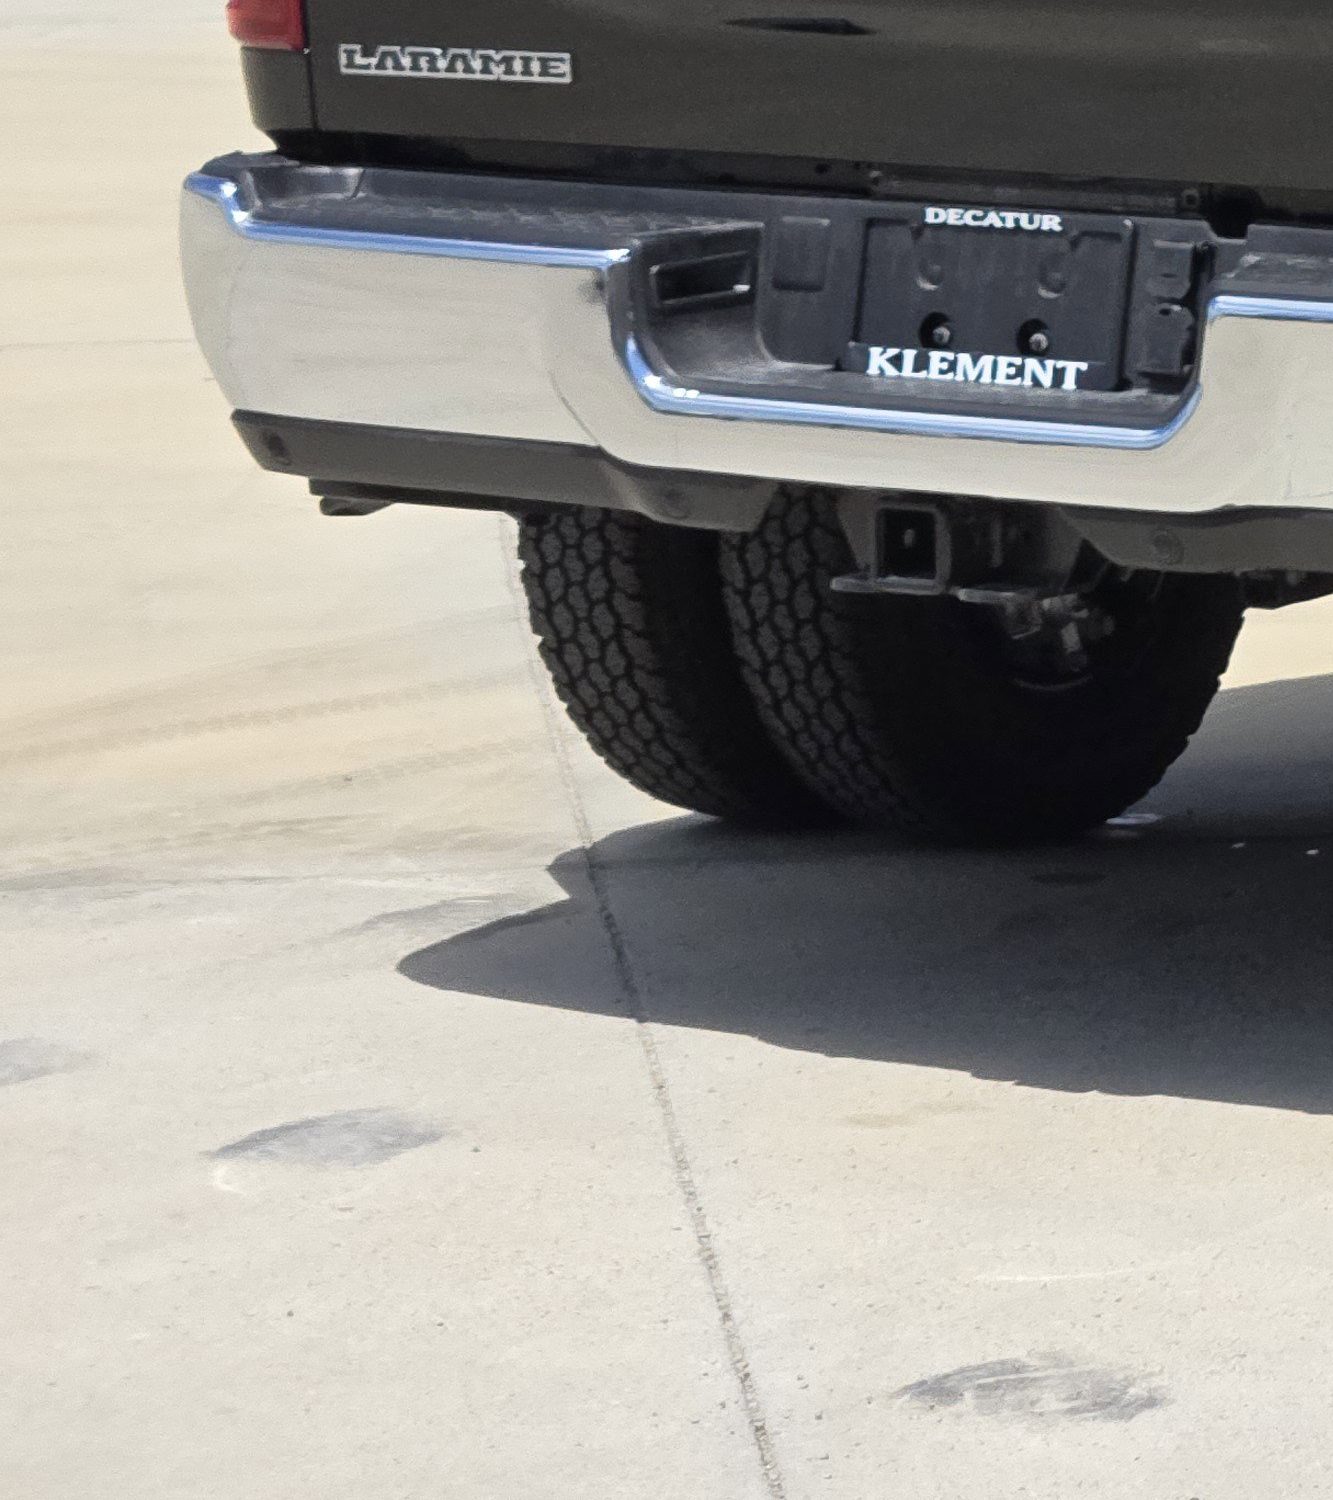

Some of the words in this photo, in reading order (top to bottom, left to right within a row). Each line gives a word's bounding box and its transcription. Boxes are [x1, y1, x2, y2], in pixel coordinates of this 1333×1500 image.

[338, 43, 573, 84] LARAMIE
[923, 206, 1064, 233] DECATUR
[865, 345, 1089, 391] KLEMENT
